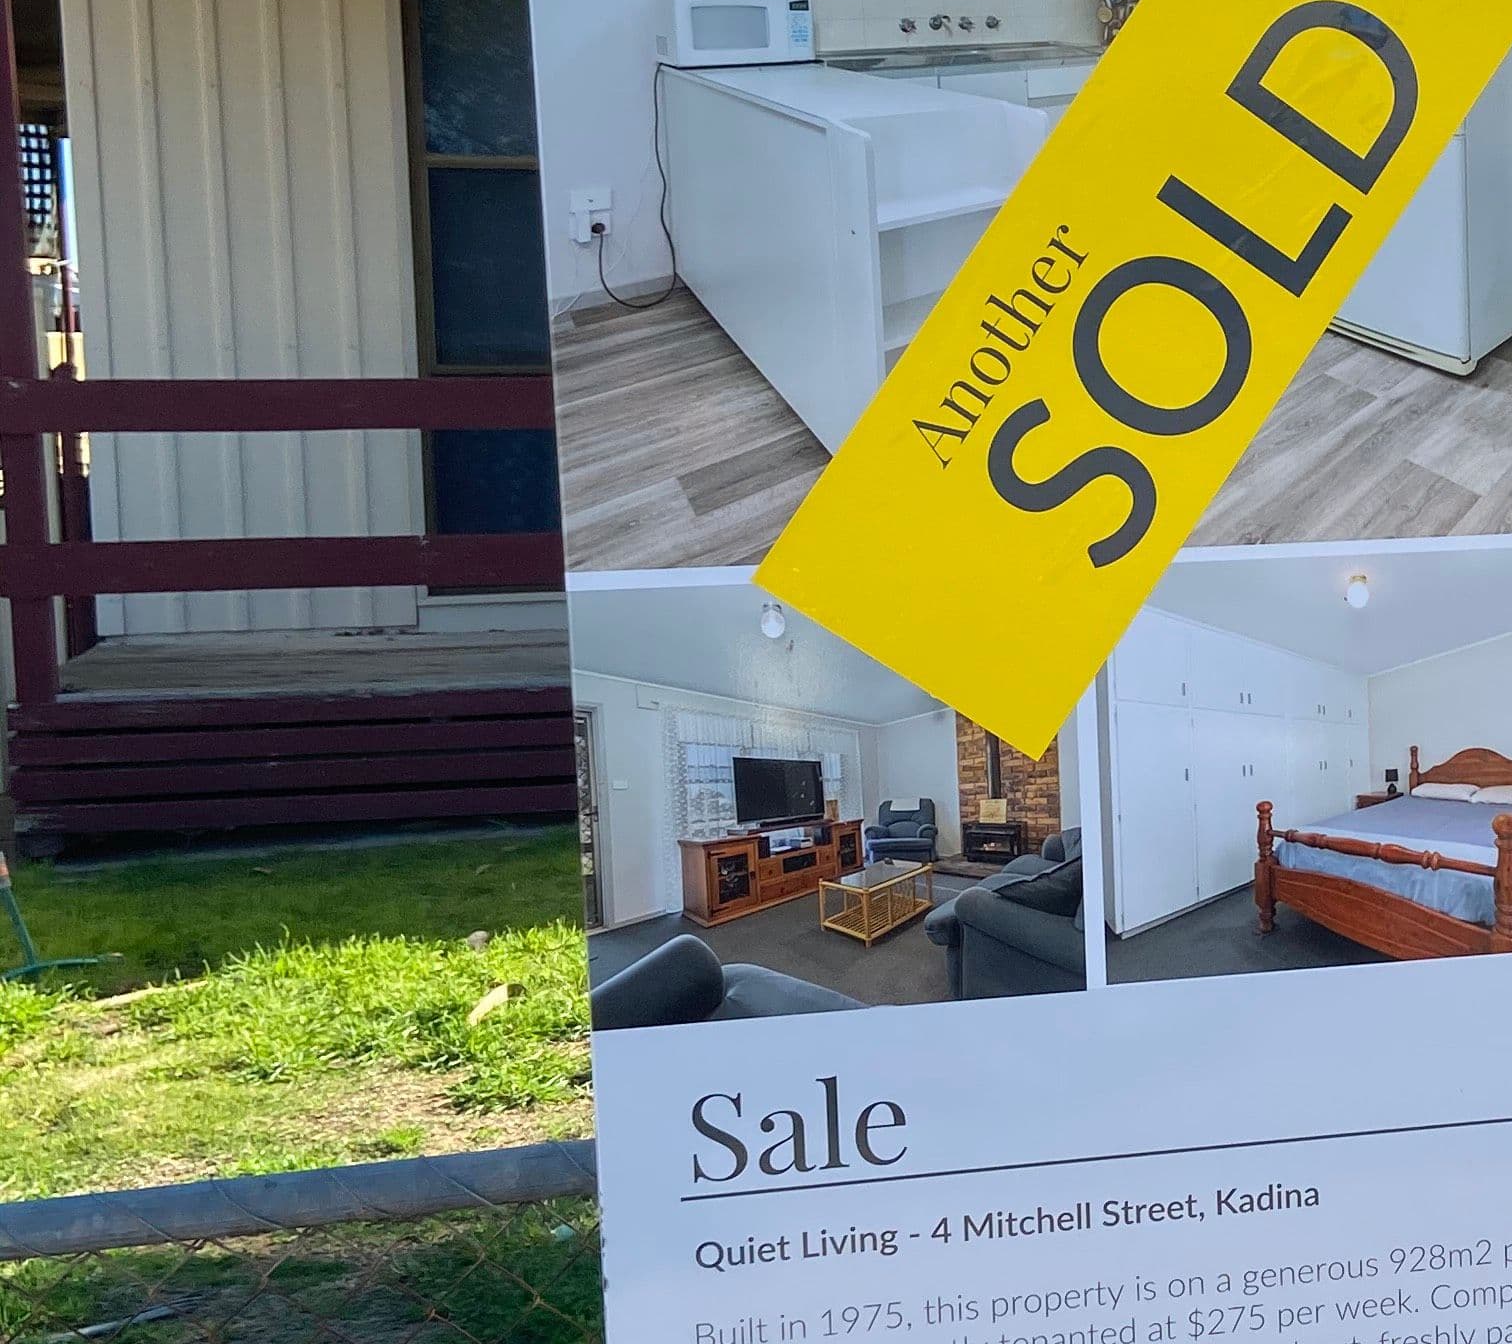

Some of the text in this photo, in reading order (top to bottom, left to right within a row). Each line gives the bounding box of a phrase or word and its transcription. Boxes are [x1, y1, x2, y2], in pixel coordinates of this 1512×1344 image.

[987, 0, 1419, 568] SOLD
[911, 224, 1090, 469] Another
[690, 1075, 908, 1183] Sale
[696, 1236, 791, 1272] Quiet
[802, 1226, 898, 1258] Living
[931, 1217, 952, 1243] 4
[964, 1202, 1091, 1241] Mitchell
[1103, 1194, 1205, 1226] Street,
[1217, 1183, 1319, 1215] Kadina
[780, 1315, 806, 1341] in
[822, 1301, 911, 1336] 1975,
[924, 1295, 979, 1324] this
[992, 1281, 1124, 1323] property
[1136, 1276, 1156, 1301] is
[1168, 1277, 1204, 1297] on
[1217, 1274, 1230, 1293] a
[1243, 1258, 1378, 1296] generous
[1390, 1240, 1492, 1274] 928m2
[1148, 1315, 1176, 1342] at
[1188, 1304, 1264, 1341] $275
[1279, 1304, 1325, 1333] per
[1335, 1289, 1418, 1320] week.
